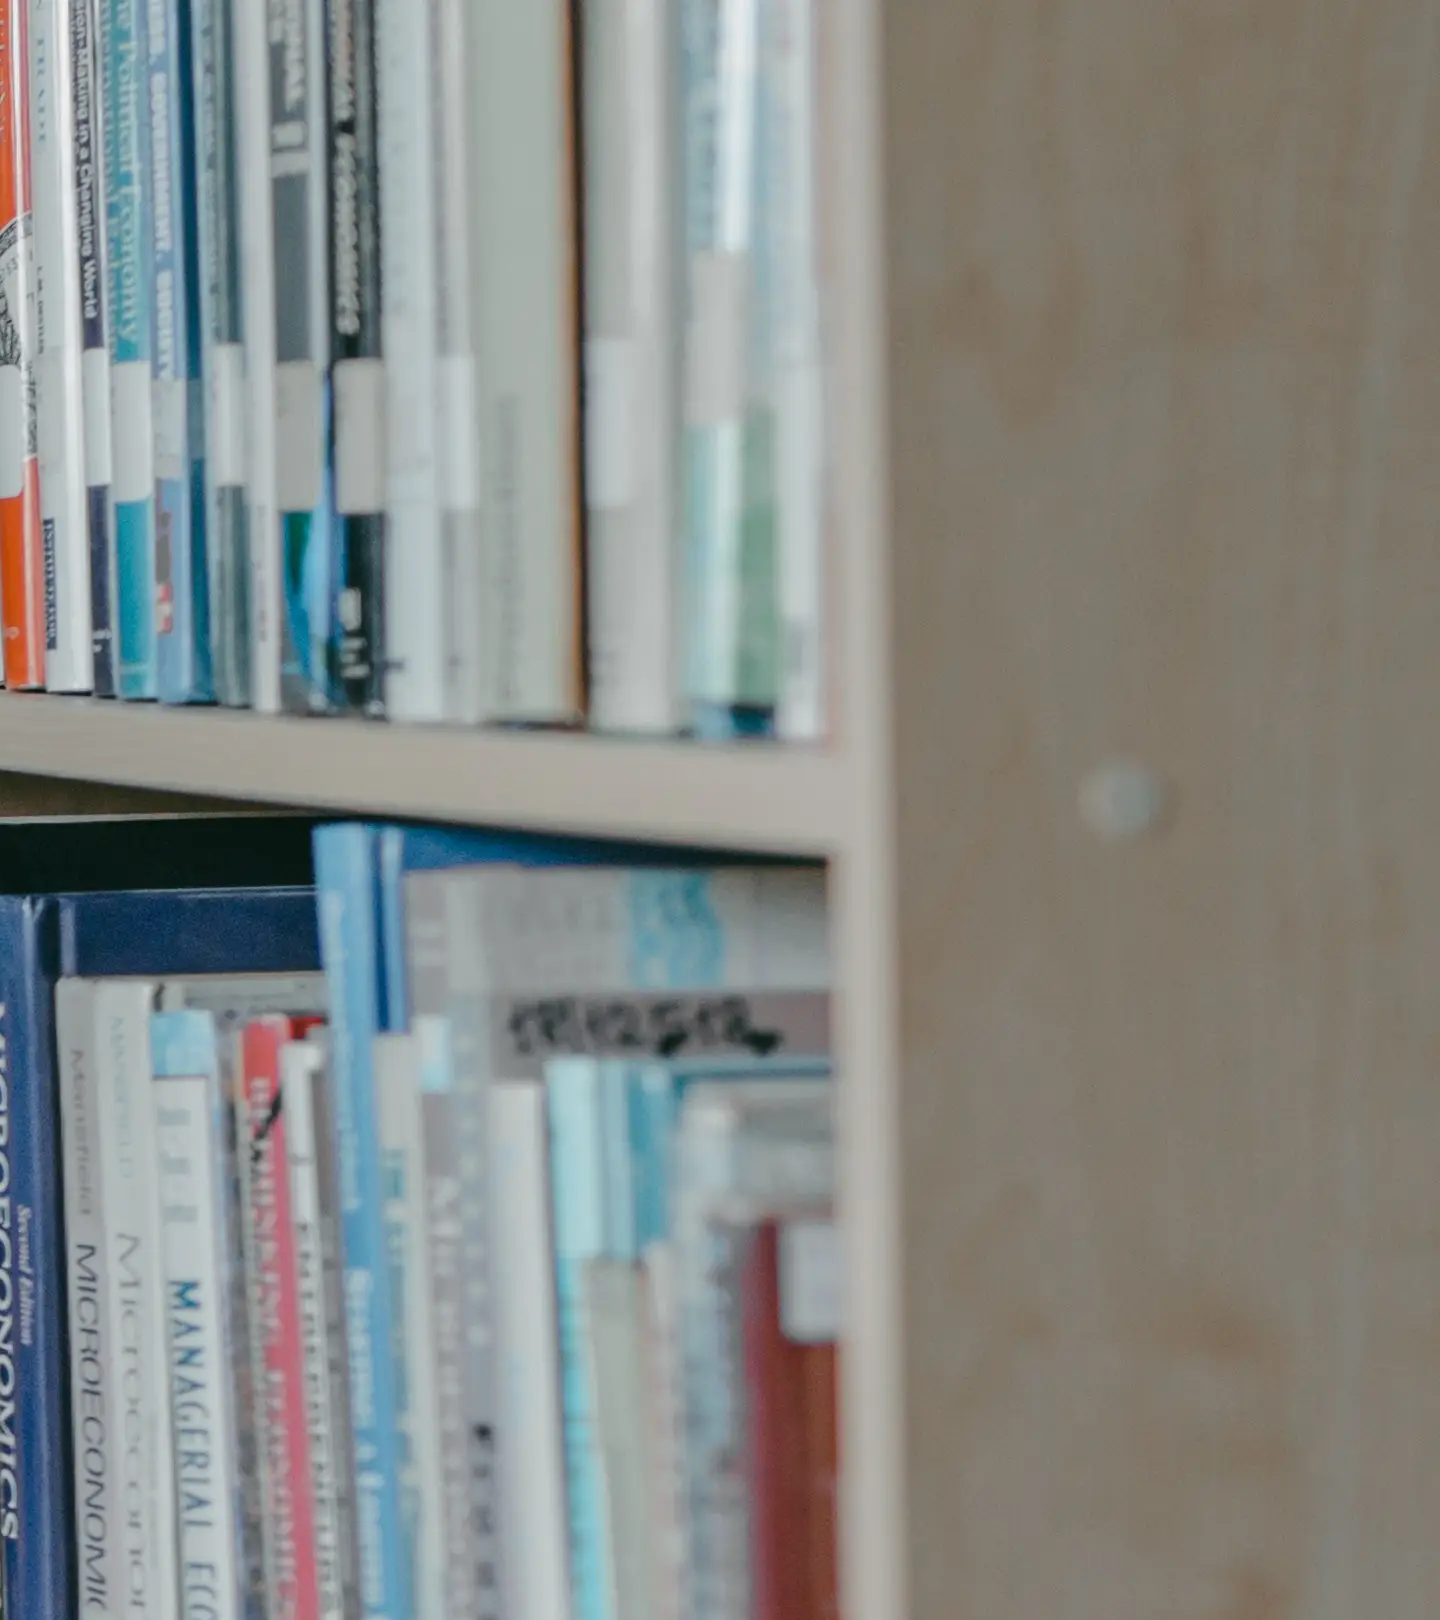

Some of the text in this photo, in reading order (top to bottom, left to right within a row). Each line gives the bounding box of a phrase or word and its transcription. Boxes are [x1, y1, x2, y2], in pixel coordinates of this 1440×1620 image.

[75, 162, 97, 320] Changing World
[171, 1279, 214, 1529] MANAGERIAL
